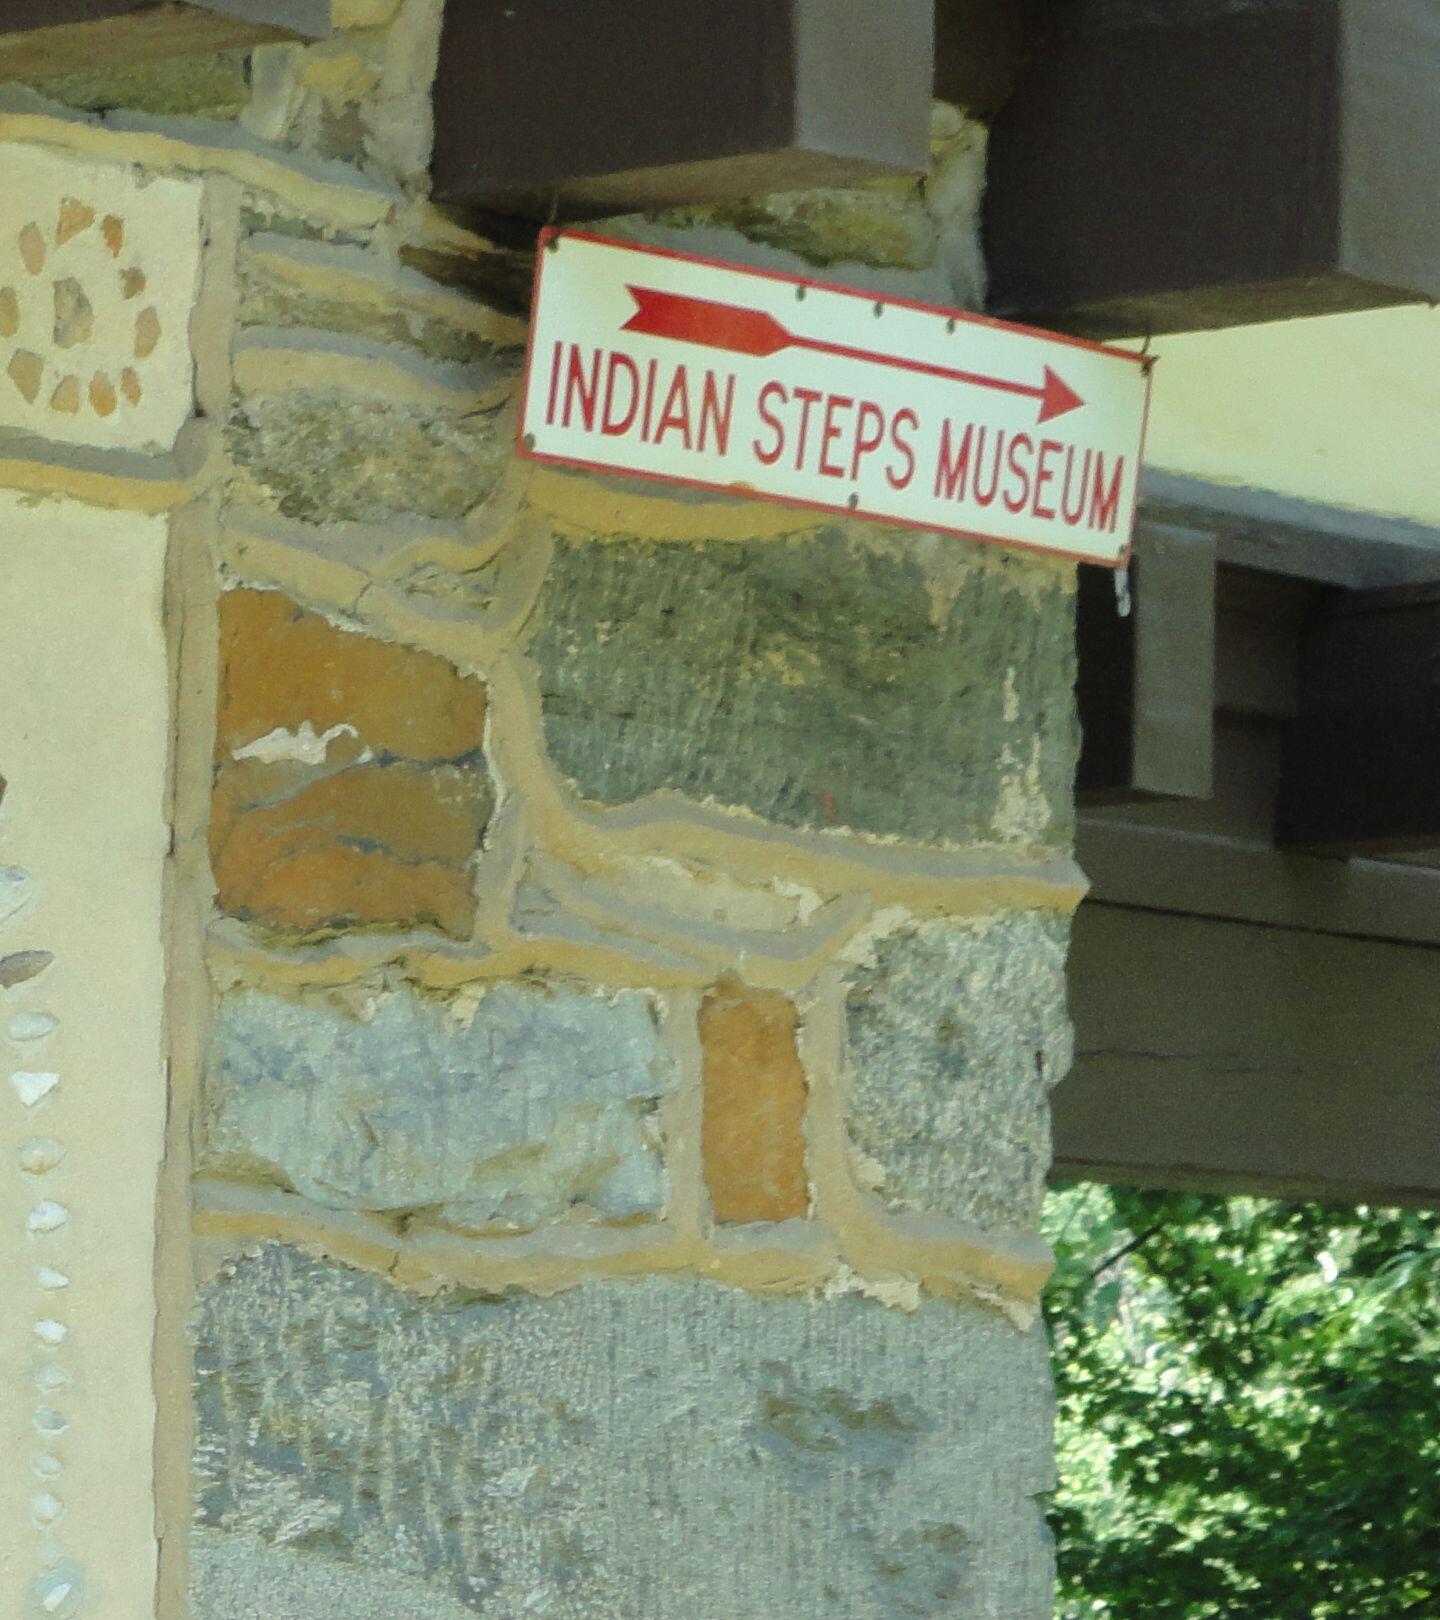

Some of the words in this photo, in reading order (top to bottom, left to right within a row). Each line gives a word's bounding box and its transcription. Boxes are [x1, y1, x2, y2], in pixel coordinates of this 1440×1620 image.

[545, 340, 737, 456] INDIAN
[752, 380, 920, 492] STEPS
[933, 419, 1126, 533] MUSEUM
